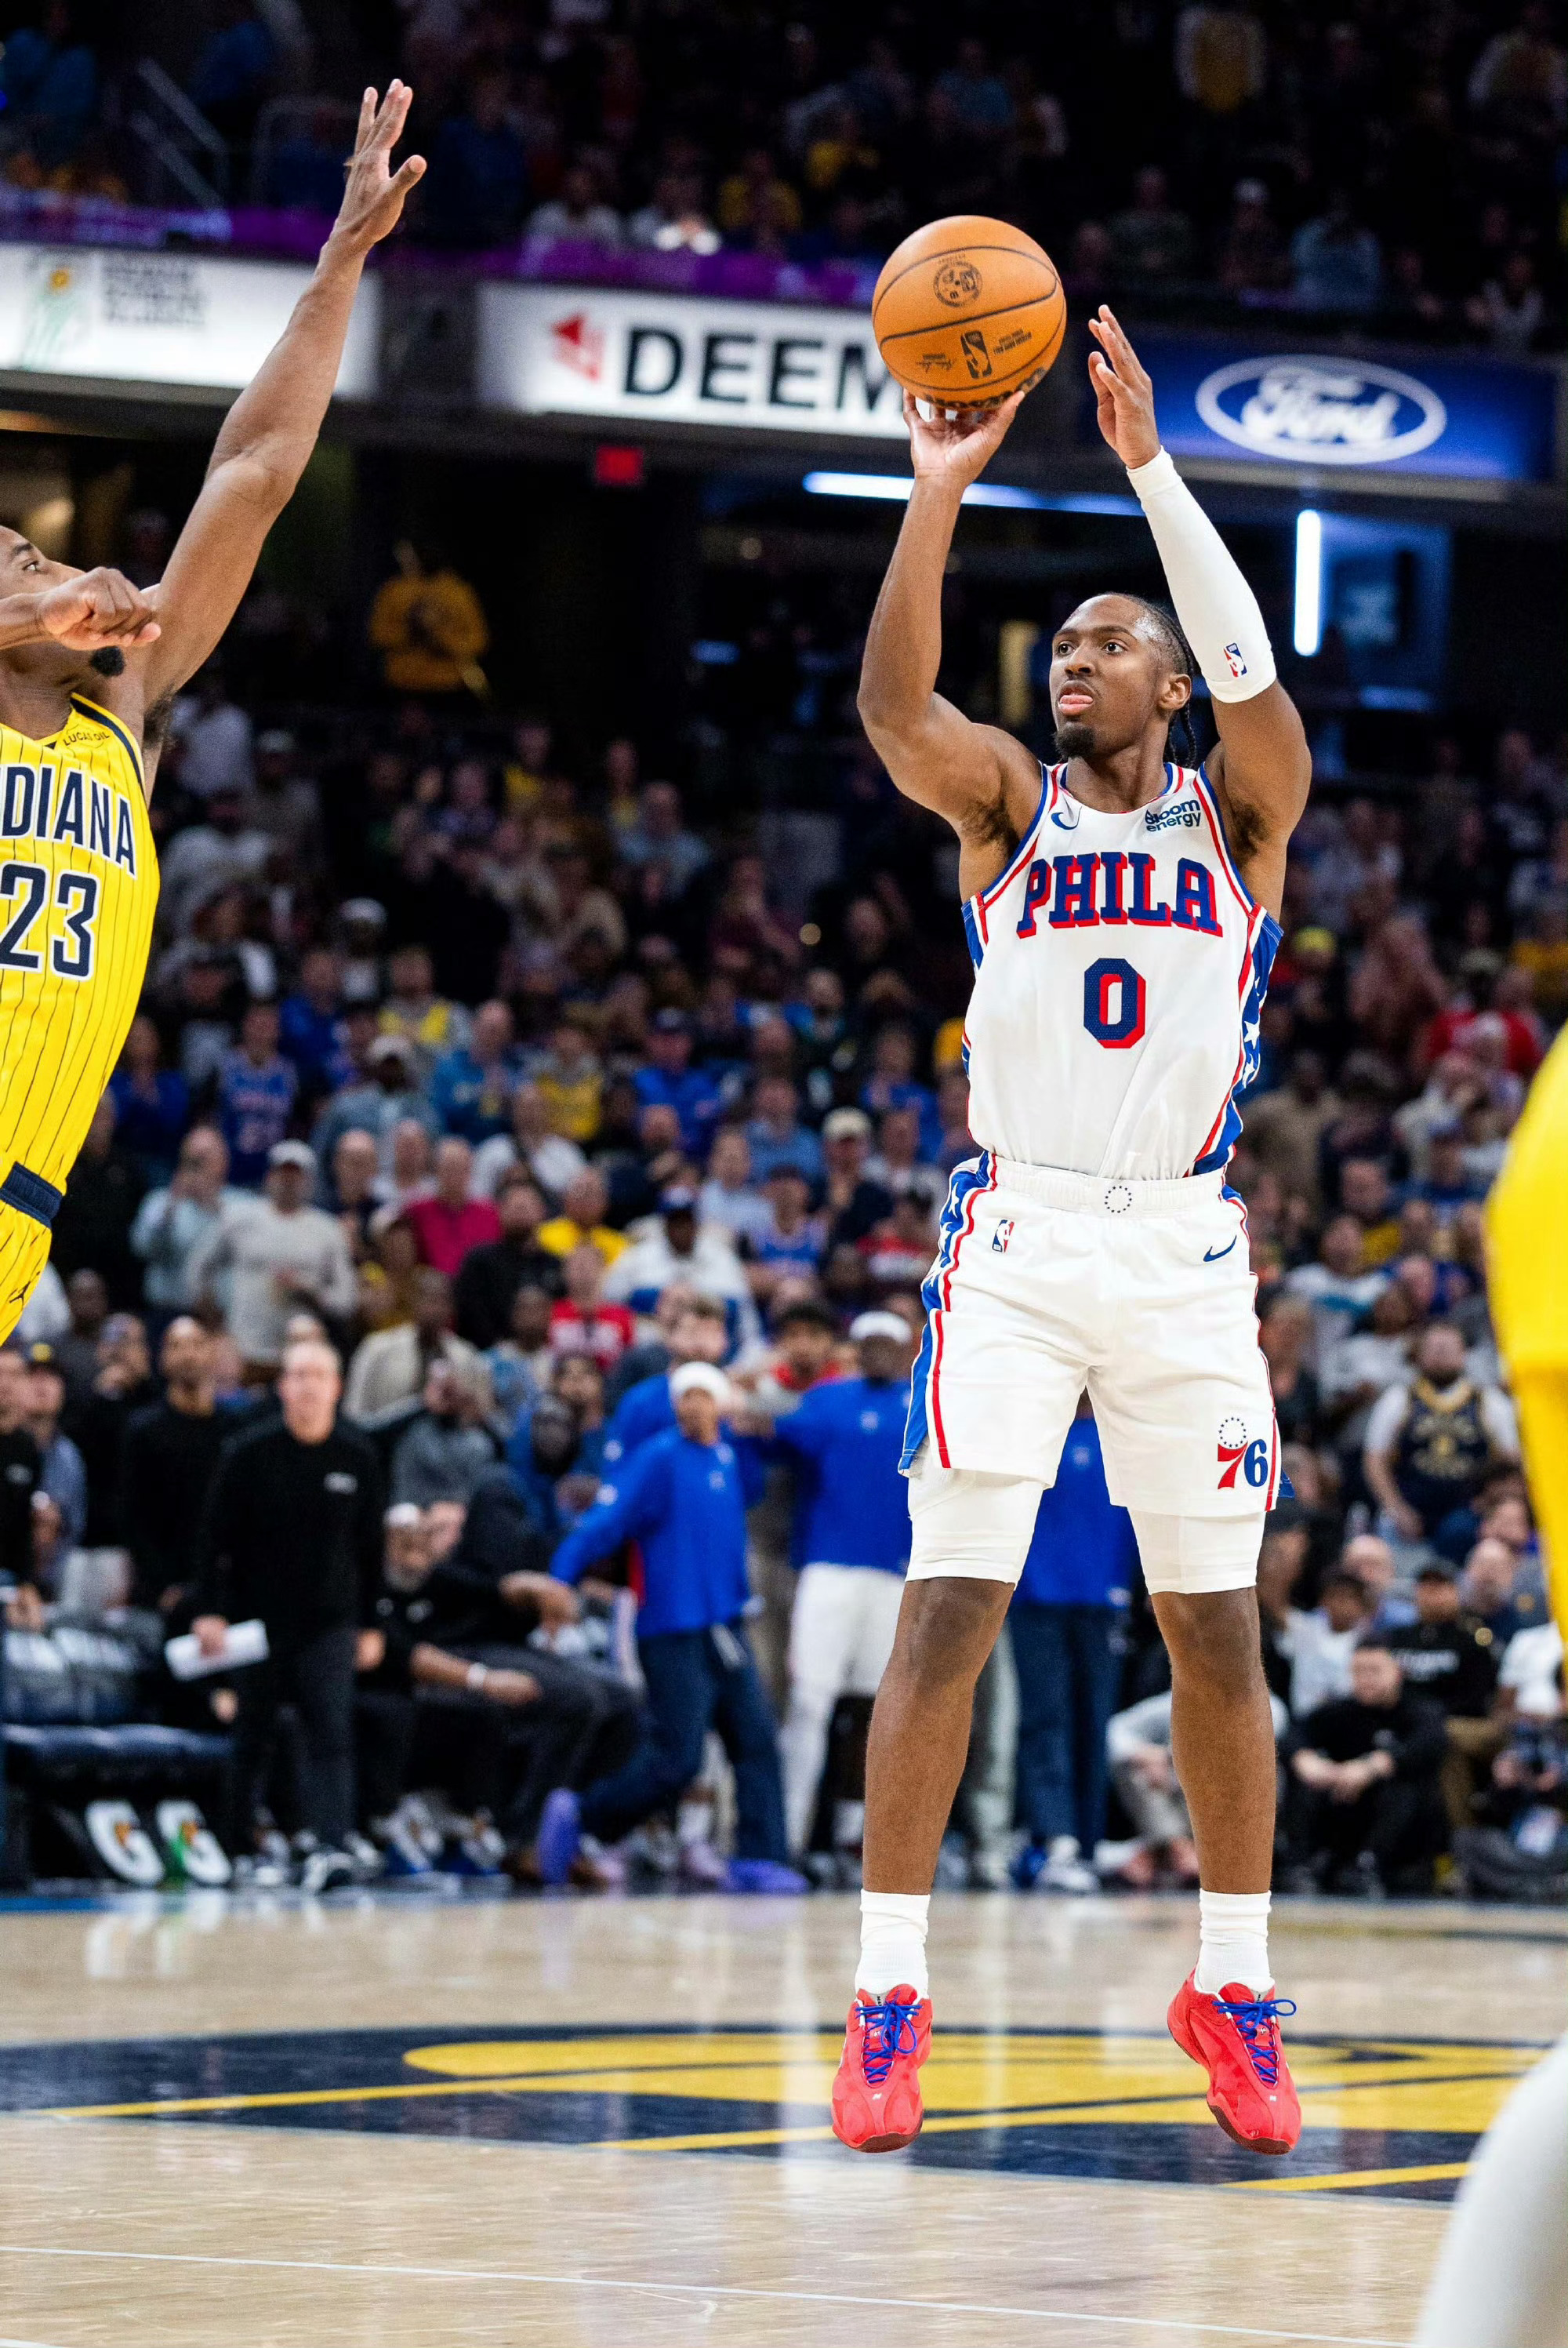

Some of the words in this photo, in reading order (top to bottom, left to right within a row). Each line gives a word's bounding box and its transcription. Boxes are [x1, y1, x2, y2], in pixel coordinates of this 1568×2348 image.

[1241, 366, 1401, 441] Ford
[93, 731, 110, 741] OIL
[0, 764, 137, 880] DIANA
[1146, 812, 1201, 832] energy
[0, 860, 100, 981] 23
[1016, 852, 1223, 940] PHILA
[1083, 958, 1146, 1049] 0
[1217, 1438, 1269, 1489] 76
